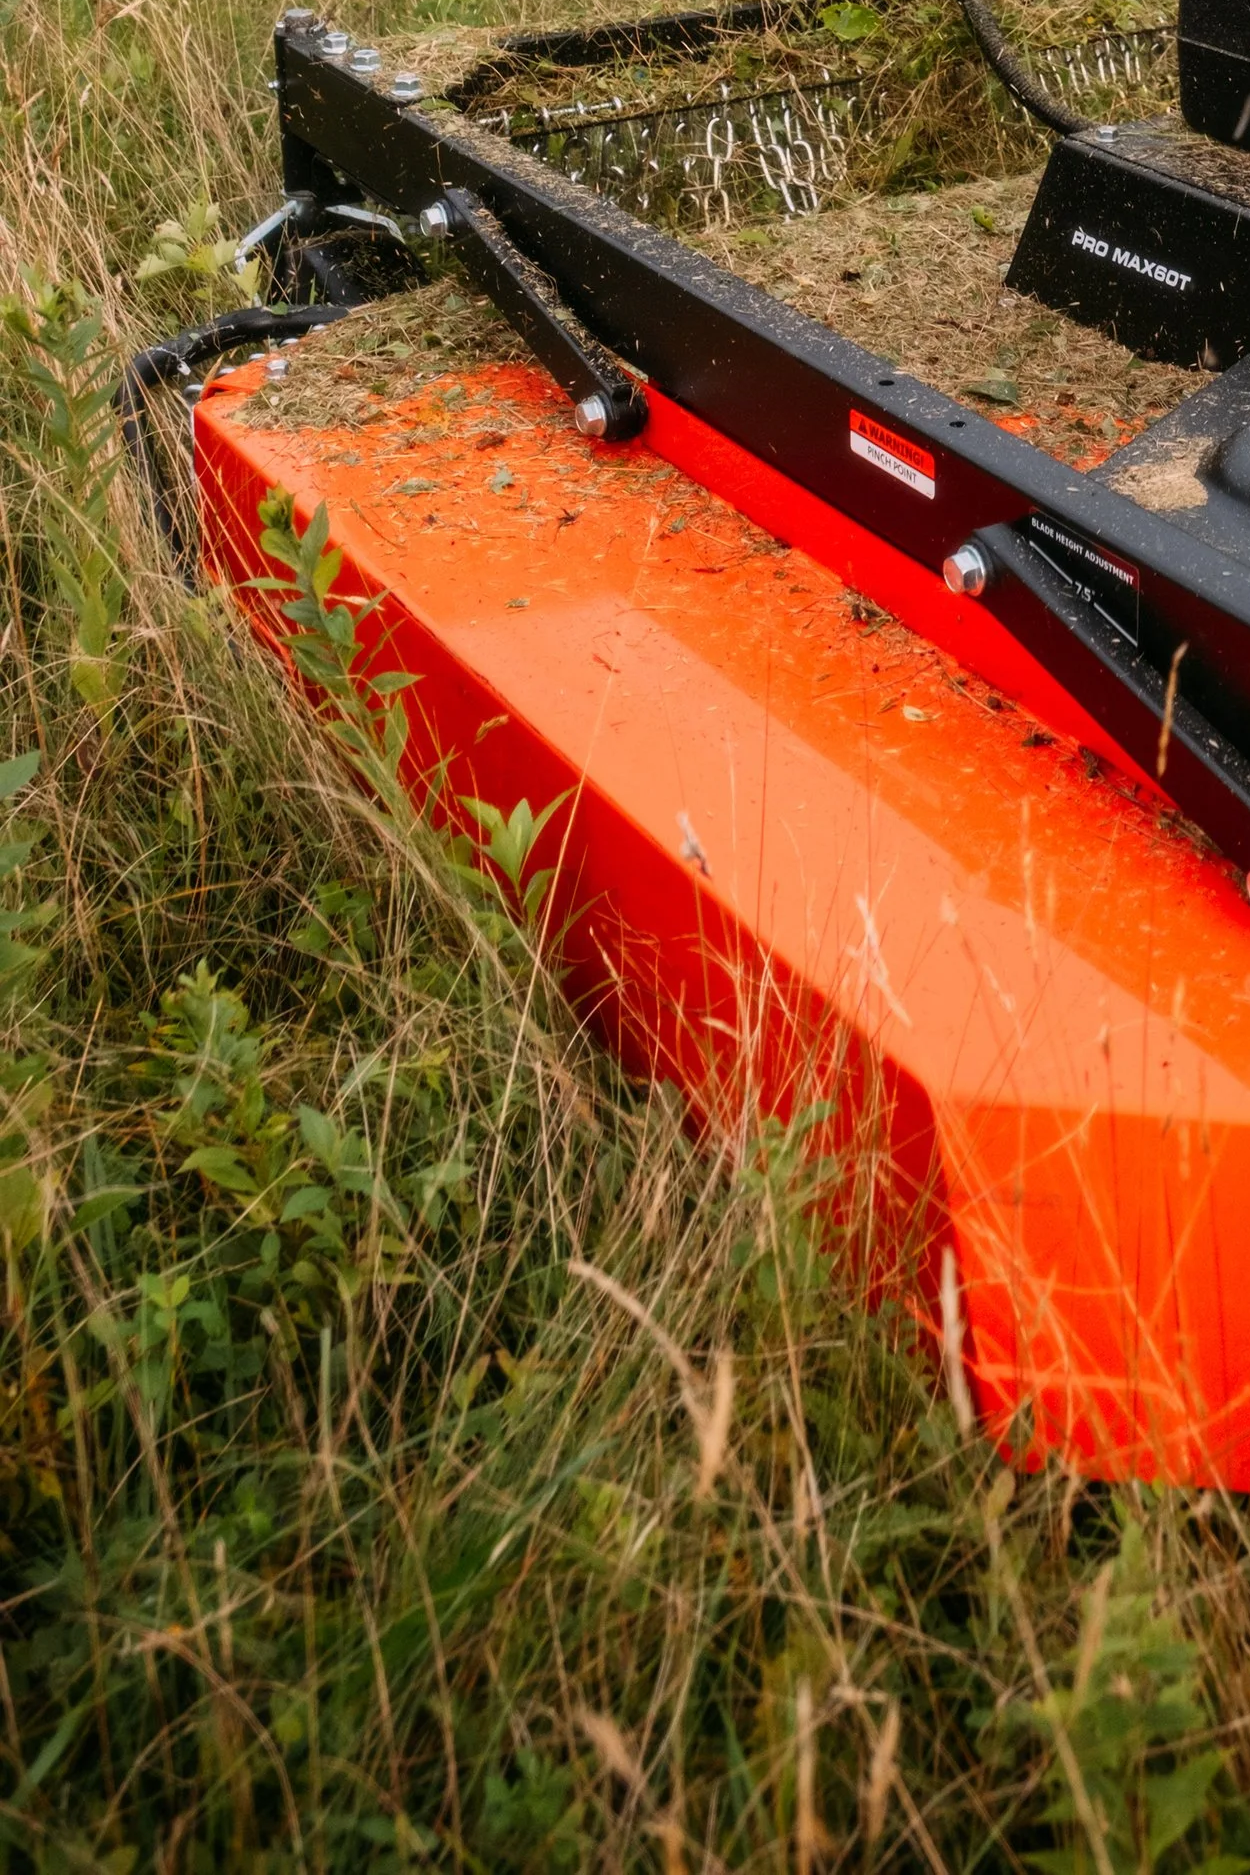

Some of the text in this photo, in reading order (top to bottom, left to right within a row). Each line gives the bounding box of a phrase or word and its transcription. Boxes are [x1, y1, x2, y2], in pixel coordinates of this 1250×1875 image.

[1071, 230, 1191, 291] PRO MAX60T
[867, 446, 917, 484] PINCH POINT
[1031, 517, 1134, 585] BLADE HEIGHT ADJUSTMENT
